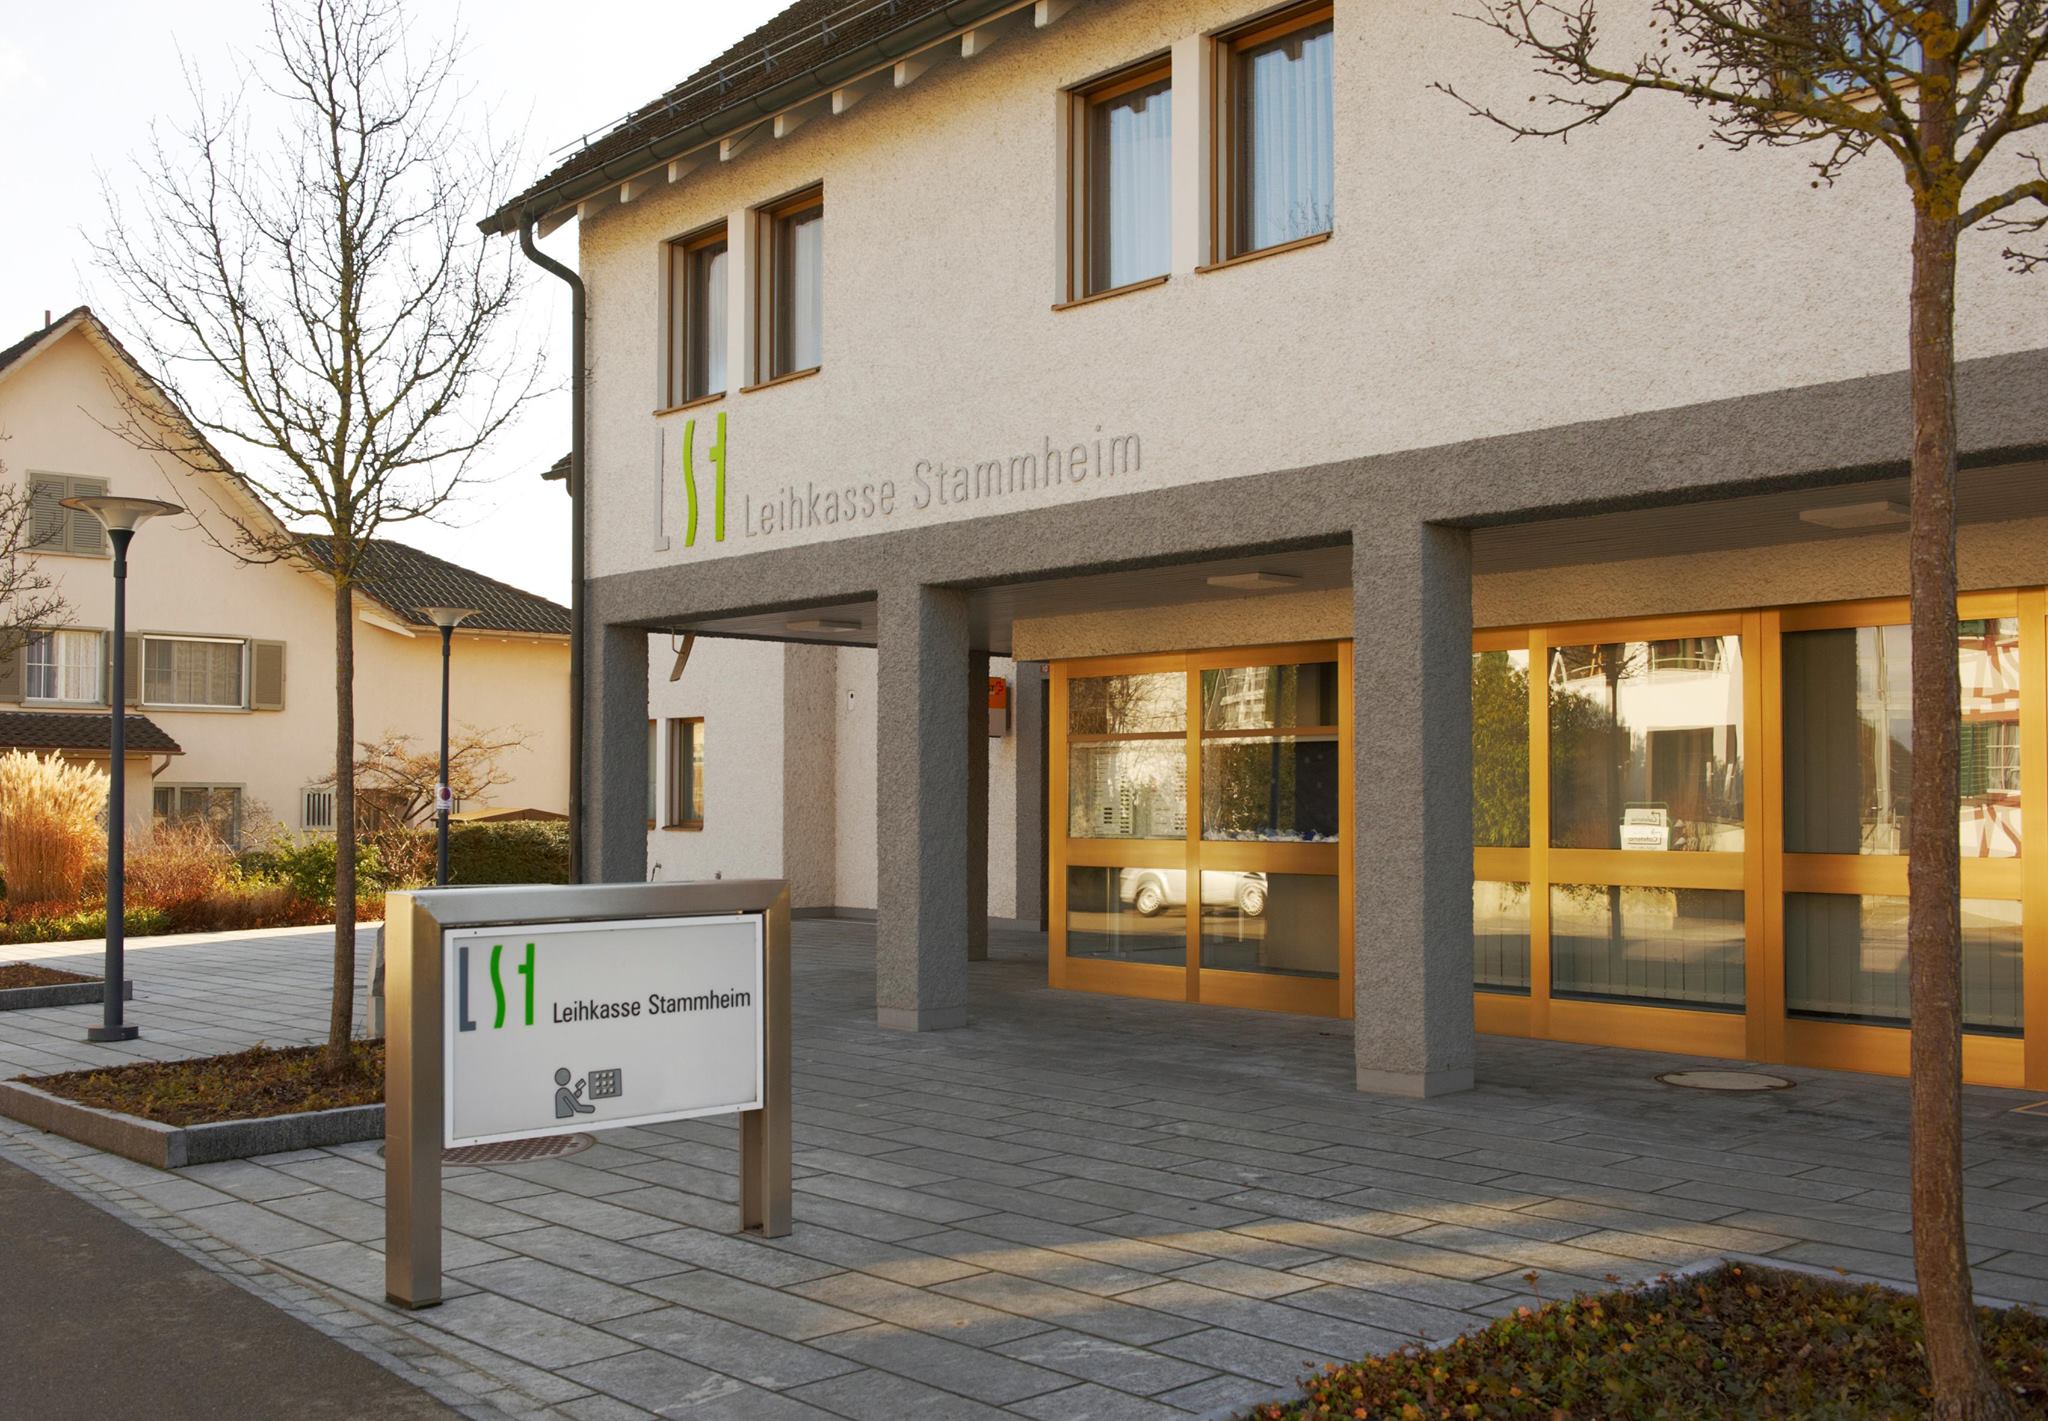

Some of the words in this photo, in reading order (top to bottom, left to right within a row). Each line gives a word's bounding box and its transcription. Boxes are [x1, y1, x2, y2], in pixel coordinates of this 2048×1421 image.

[744, 478, 896, 538] Leihkasse
[914, 425, 1142, 511] Stammheim
[553, 1000, 641, 1023] Leihkasse
[648, 988, 751, 1015] Stammheim
